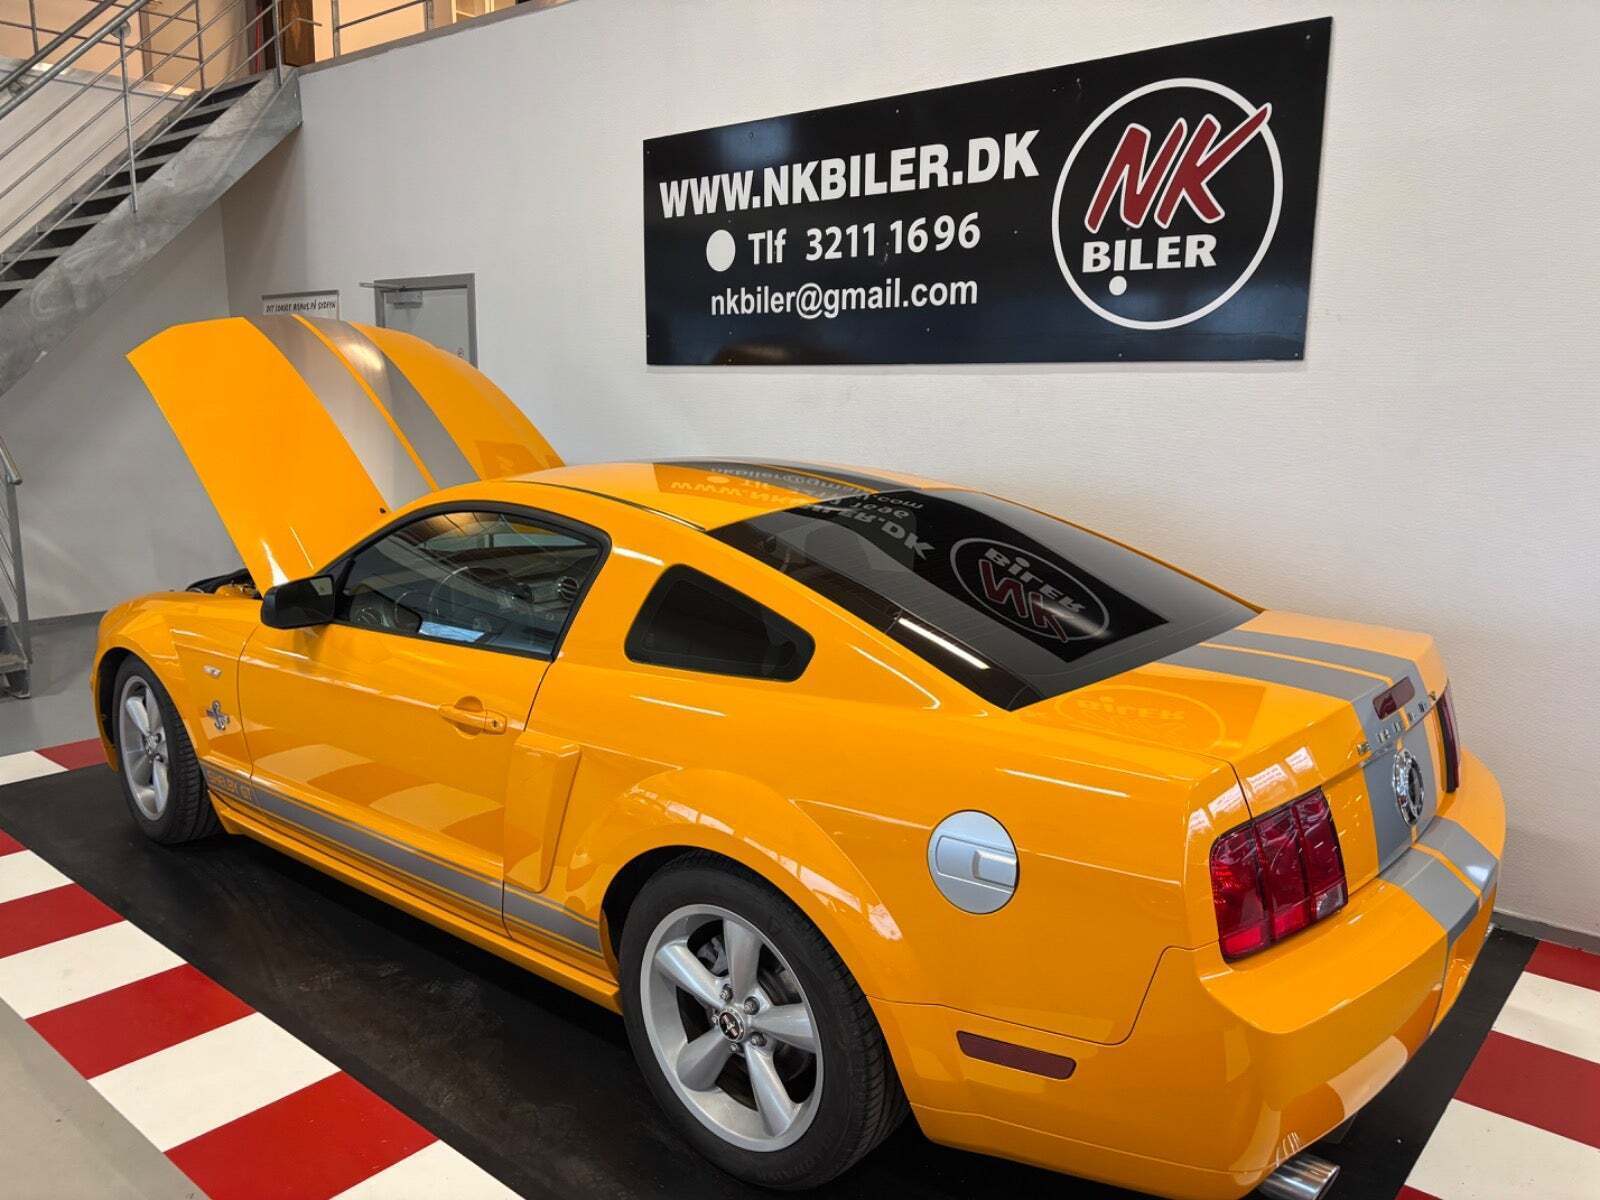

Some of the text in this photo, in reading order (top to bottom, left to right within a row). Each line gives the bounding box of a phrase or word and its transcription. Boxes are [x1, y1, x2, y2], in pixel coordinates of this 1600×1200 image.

[659, 129, 1040, 219] WWW.NKBILER.DK
[1084, 102, 1272, 234] NK
[748, 212, 981, 266] Tlf 3211 1696
[1082, 234, 1217, 273] BILER
[710, 277, 978, 319] nkbiler@gmail.com
